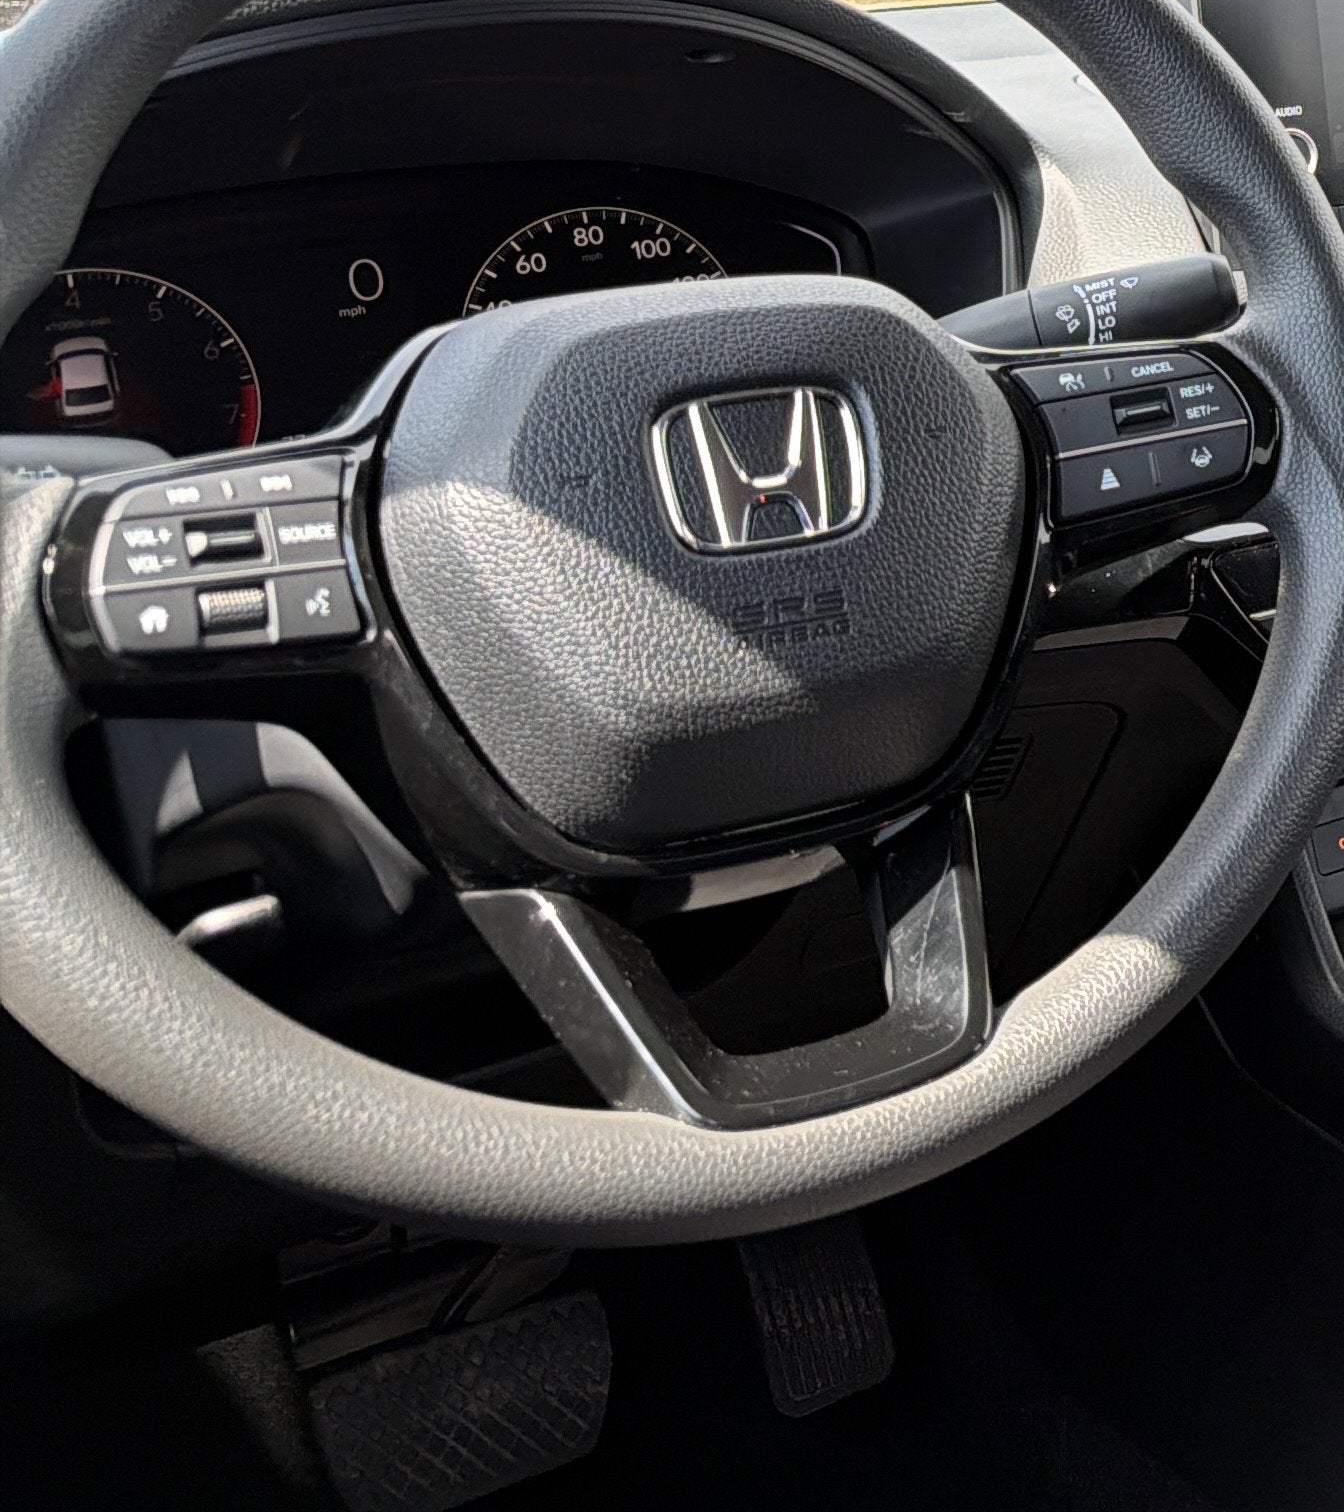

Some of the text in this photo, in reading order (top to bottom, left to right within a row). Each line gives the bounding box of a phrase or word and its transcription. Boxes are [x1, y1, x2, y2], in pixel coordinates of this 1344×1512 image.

[1274, 105, 1302, 117] AUDIO
[573, 225, 604, 247] 80
[630, 236, 672, 259] 100
[515, 252, 547, 275] 60
[581, 251, 603, 263] mph
[348, 258, 384, 302] 0
[1084, 277, 1116, 292] MIST
[64, 291, 81, 309] 4
[1091, 288, 1118, 305] OFF
[148, 302, 163, 322] 5
[338, 304, 367, 319] mph
[1095, 301, 1117, 315] INT
[1098, 316, 1117, 330] LO
[1099, 331, 1114, 343] HI
[204, 341, 220, 360] 6
[1130, 360, 1175, 379] CANCEL
[278, 521, 337, 545] SOURCE
